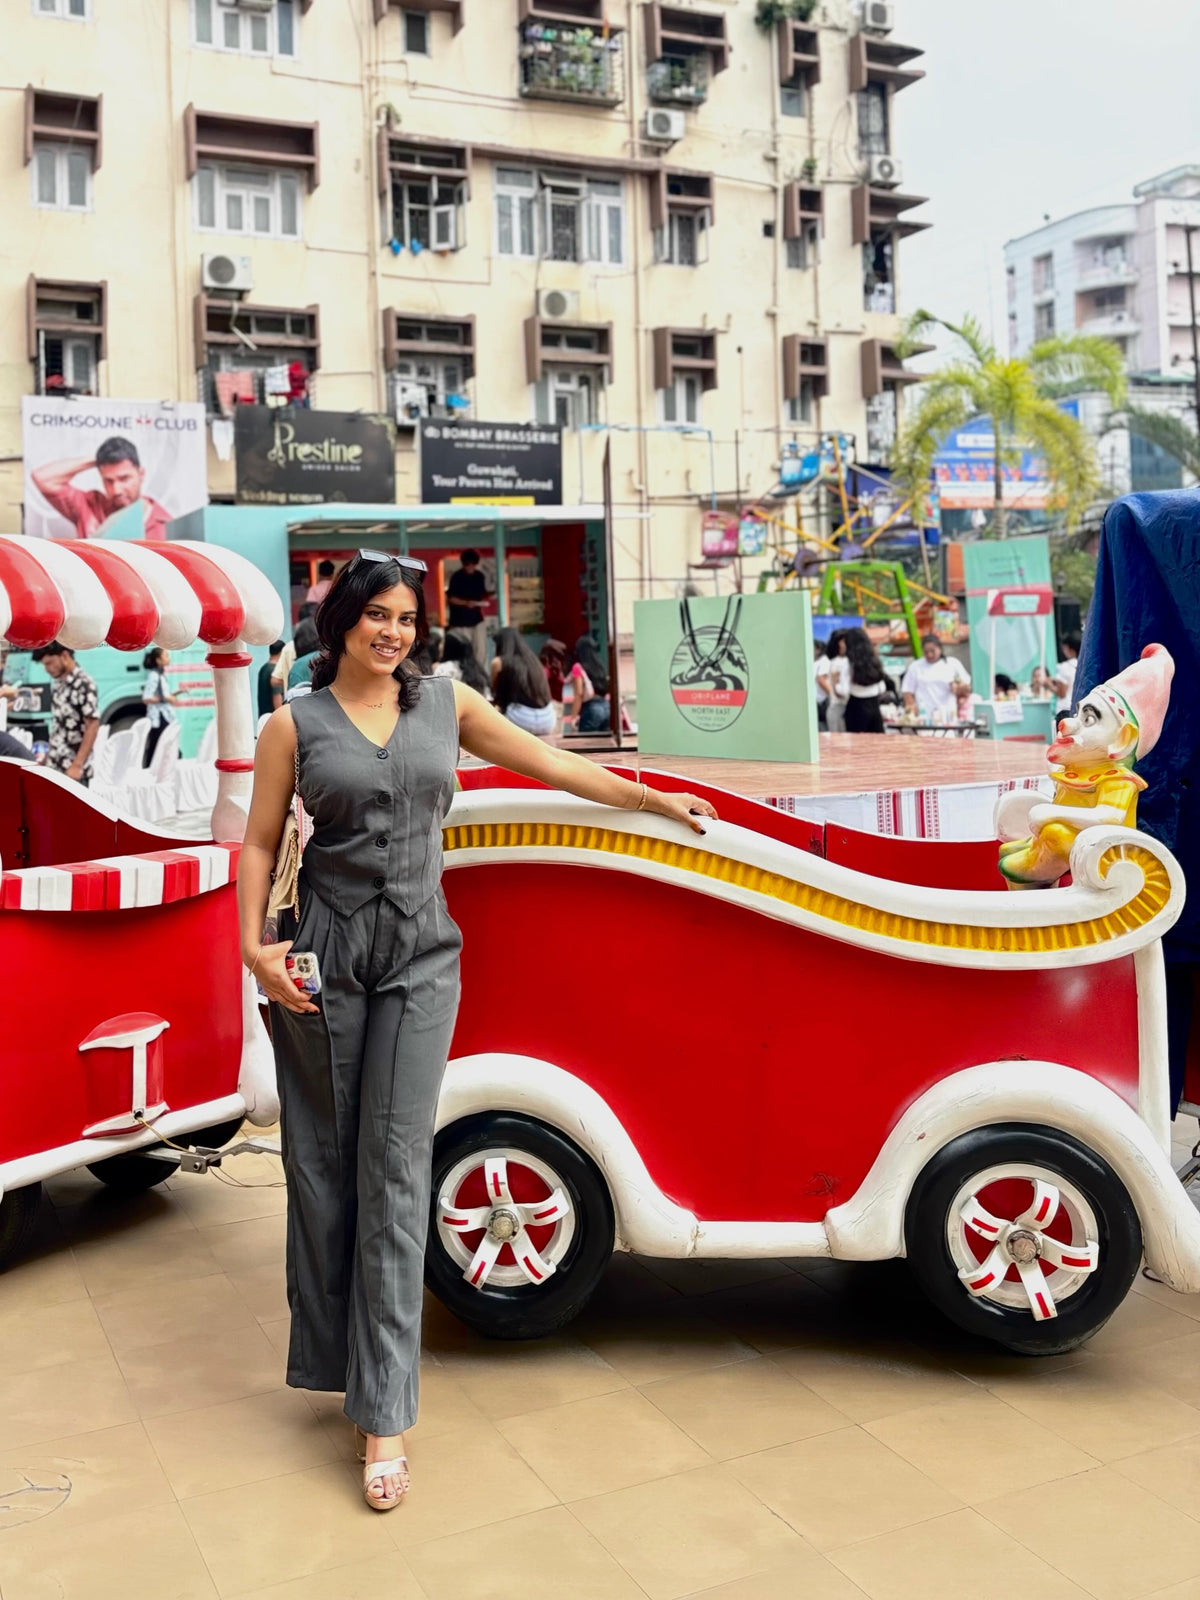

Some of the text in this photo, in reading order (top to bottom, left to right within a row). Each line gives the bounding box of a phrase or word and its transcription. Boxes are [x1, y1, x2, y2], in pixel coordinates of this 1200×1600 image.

[30, 413, 198, 431] CRIMSOUNE CLUB
[442, 426, 492, 440] BOMBAY
[495, 429, 559, 444] BRASSERIE
[432, 475, 457, 488] Your
[515, 478, 554, 491] Arrived
[690, 692, 731, 701] ORIFLAME
[691, 706, 731, 716] NORTH EAST
